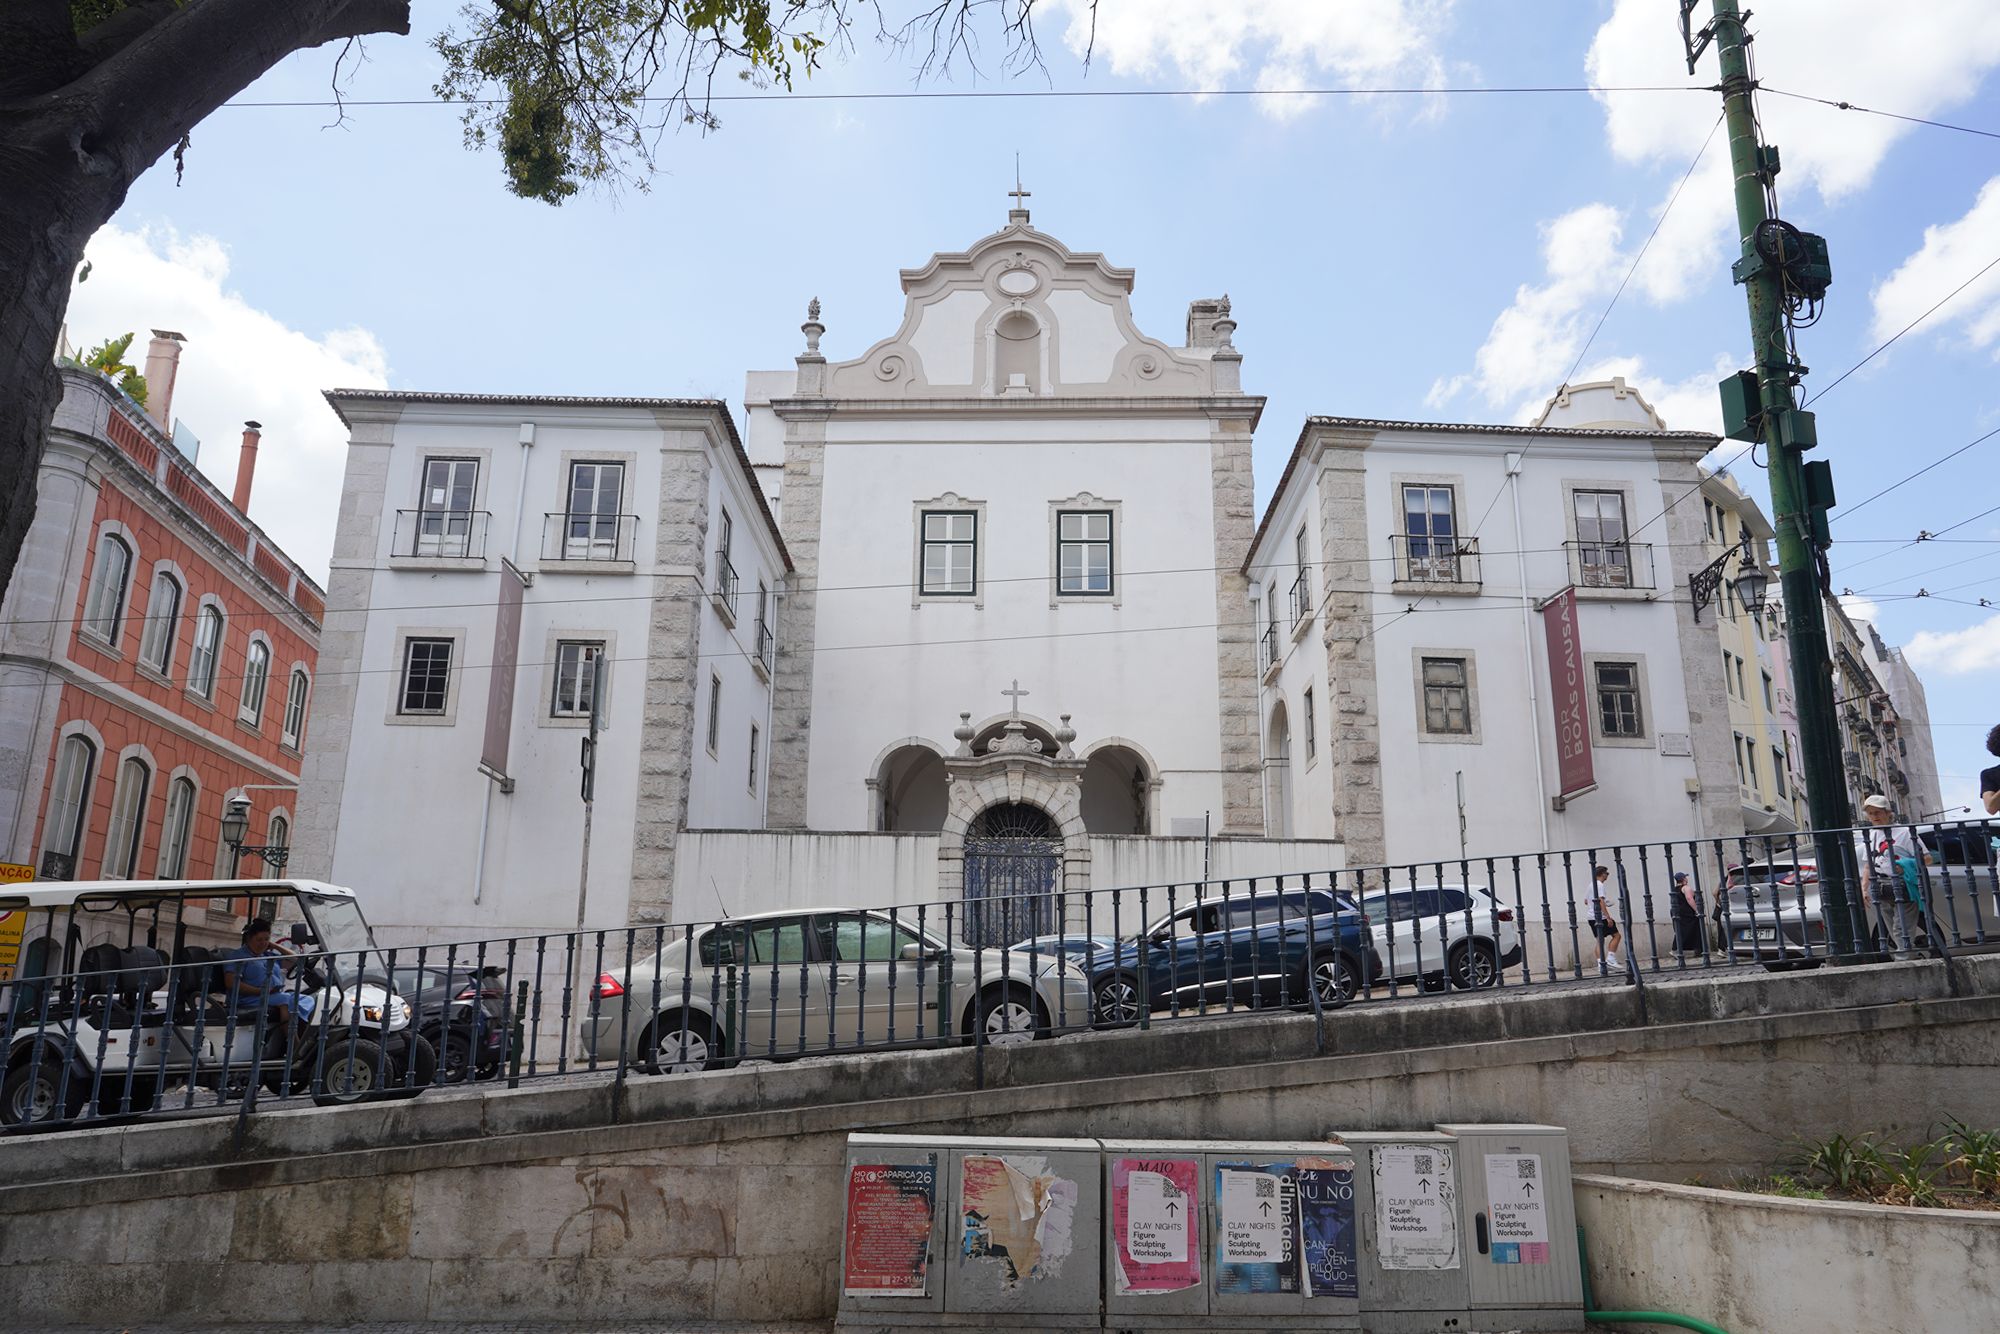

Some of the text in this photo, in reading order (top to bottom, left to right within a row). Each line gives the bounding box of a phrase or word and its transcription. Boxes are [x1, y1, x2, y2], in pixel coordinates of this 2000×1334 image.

[1559, 593, 1576, 686] CAUSAS
[1569, 690, 1584, 756] BOAS
[1560, 709, 1574, 760] POR
[1137, 1161, 1174, 1172] MAIO
[915, 1171, 932, 1184] 26
[1388, 1198, 1435, 1206] CLAY NIGHTS
[1389, 1207, 1411, 1216] Figure
[1493, 1203, 1512, 1211] CLAY
[1389, 1215, 1421, 1224] Sculpting
[1494, 1212, 1516, 1221] Figure
[1133, 1221, 1182, 1231] CLAY NIGHTS
[1227, 1221, 1276, 1230] CLAY NIGHTS
[1390, 1224, 1428, 1233] Workshops
[1495, 1220, 1527, 1229] Sculpting
[1133, 1231, 1156, 1240] Figure
[1227, 1231, 1250, 1240] Figure
[1496, 1229, 1534, 1237] Workshops
[1133, 1240, 1166, 1250] Sculpting
[1227, 1240, 1261, 1249] Sculpting
[1133, 1249, 1172, 1258] Workshops
[1227, 1249, 1267, 1258] Workshops
